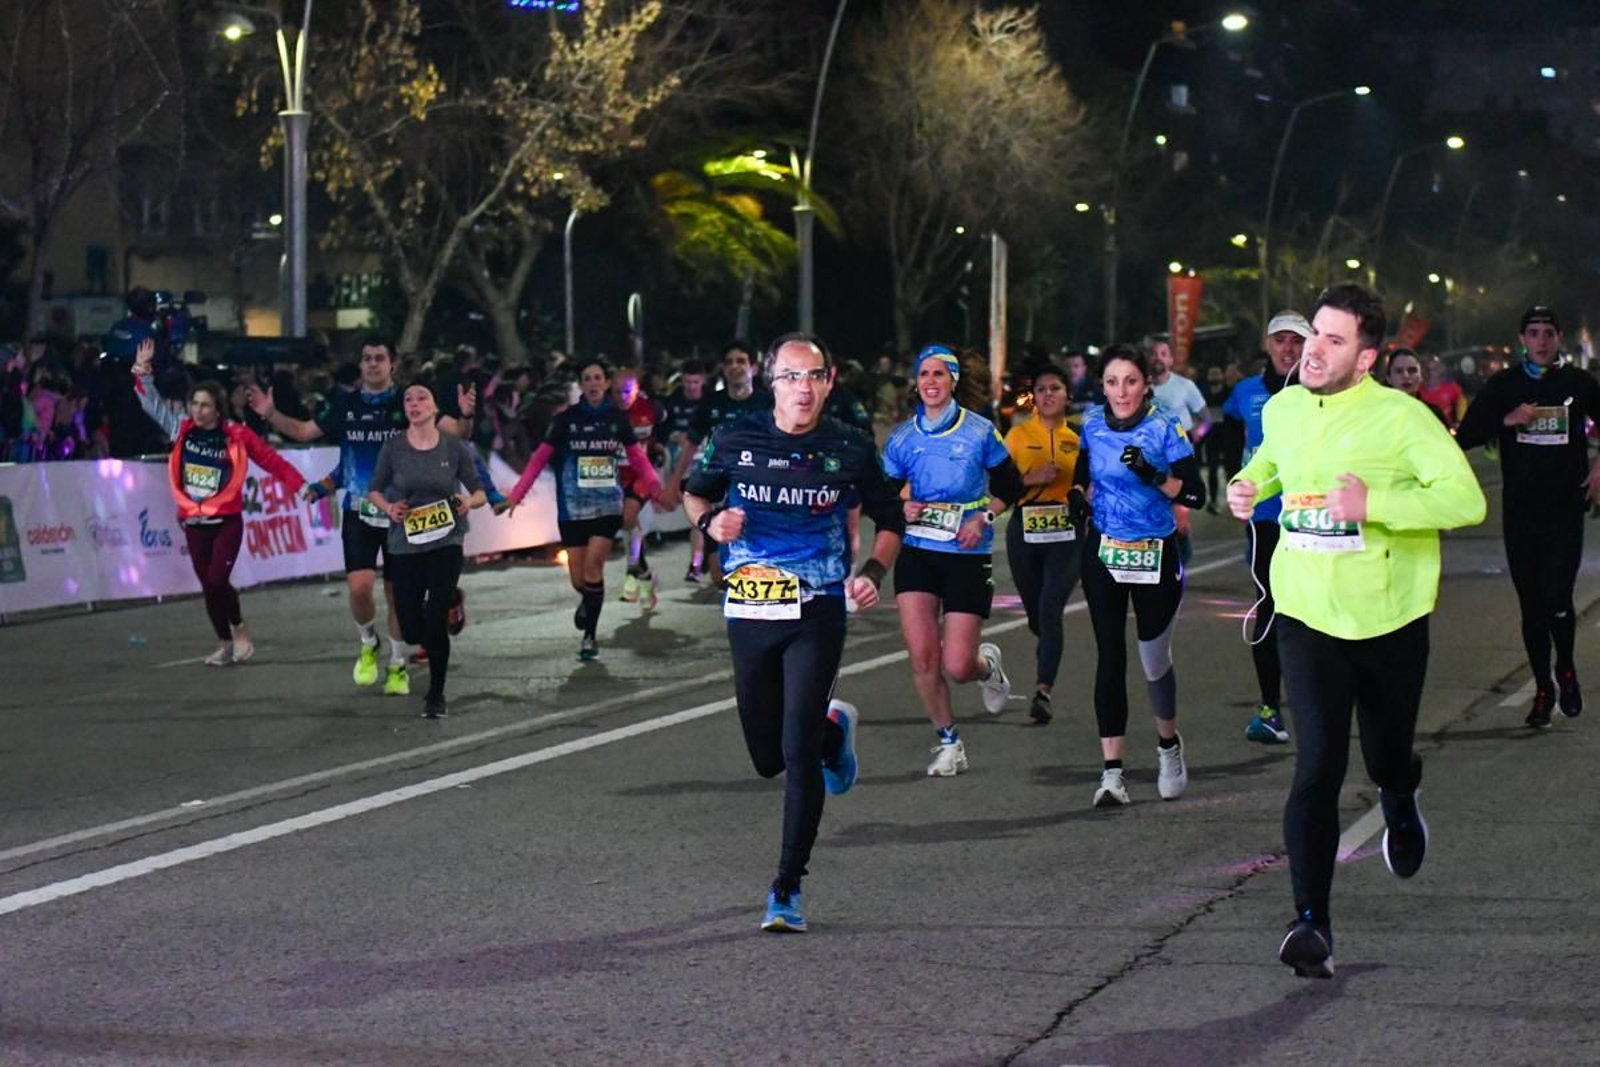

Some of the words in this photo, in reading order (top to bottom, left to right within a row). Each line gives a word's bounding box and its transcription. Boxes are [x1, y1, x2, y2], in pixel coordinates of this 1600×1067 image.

[737, 481, 772, 503] SAN
[775, 485, 841, 507] ANTÓN
[407, 510, 448, 531] 3740
[1027, 515, 1069, 530] 3343
[1104, 547, 1156, 567] 1338
[734, 579, 792, 599] 4377
